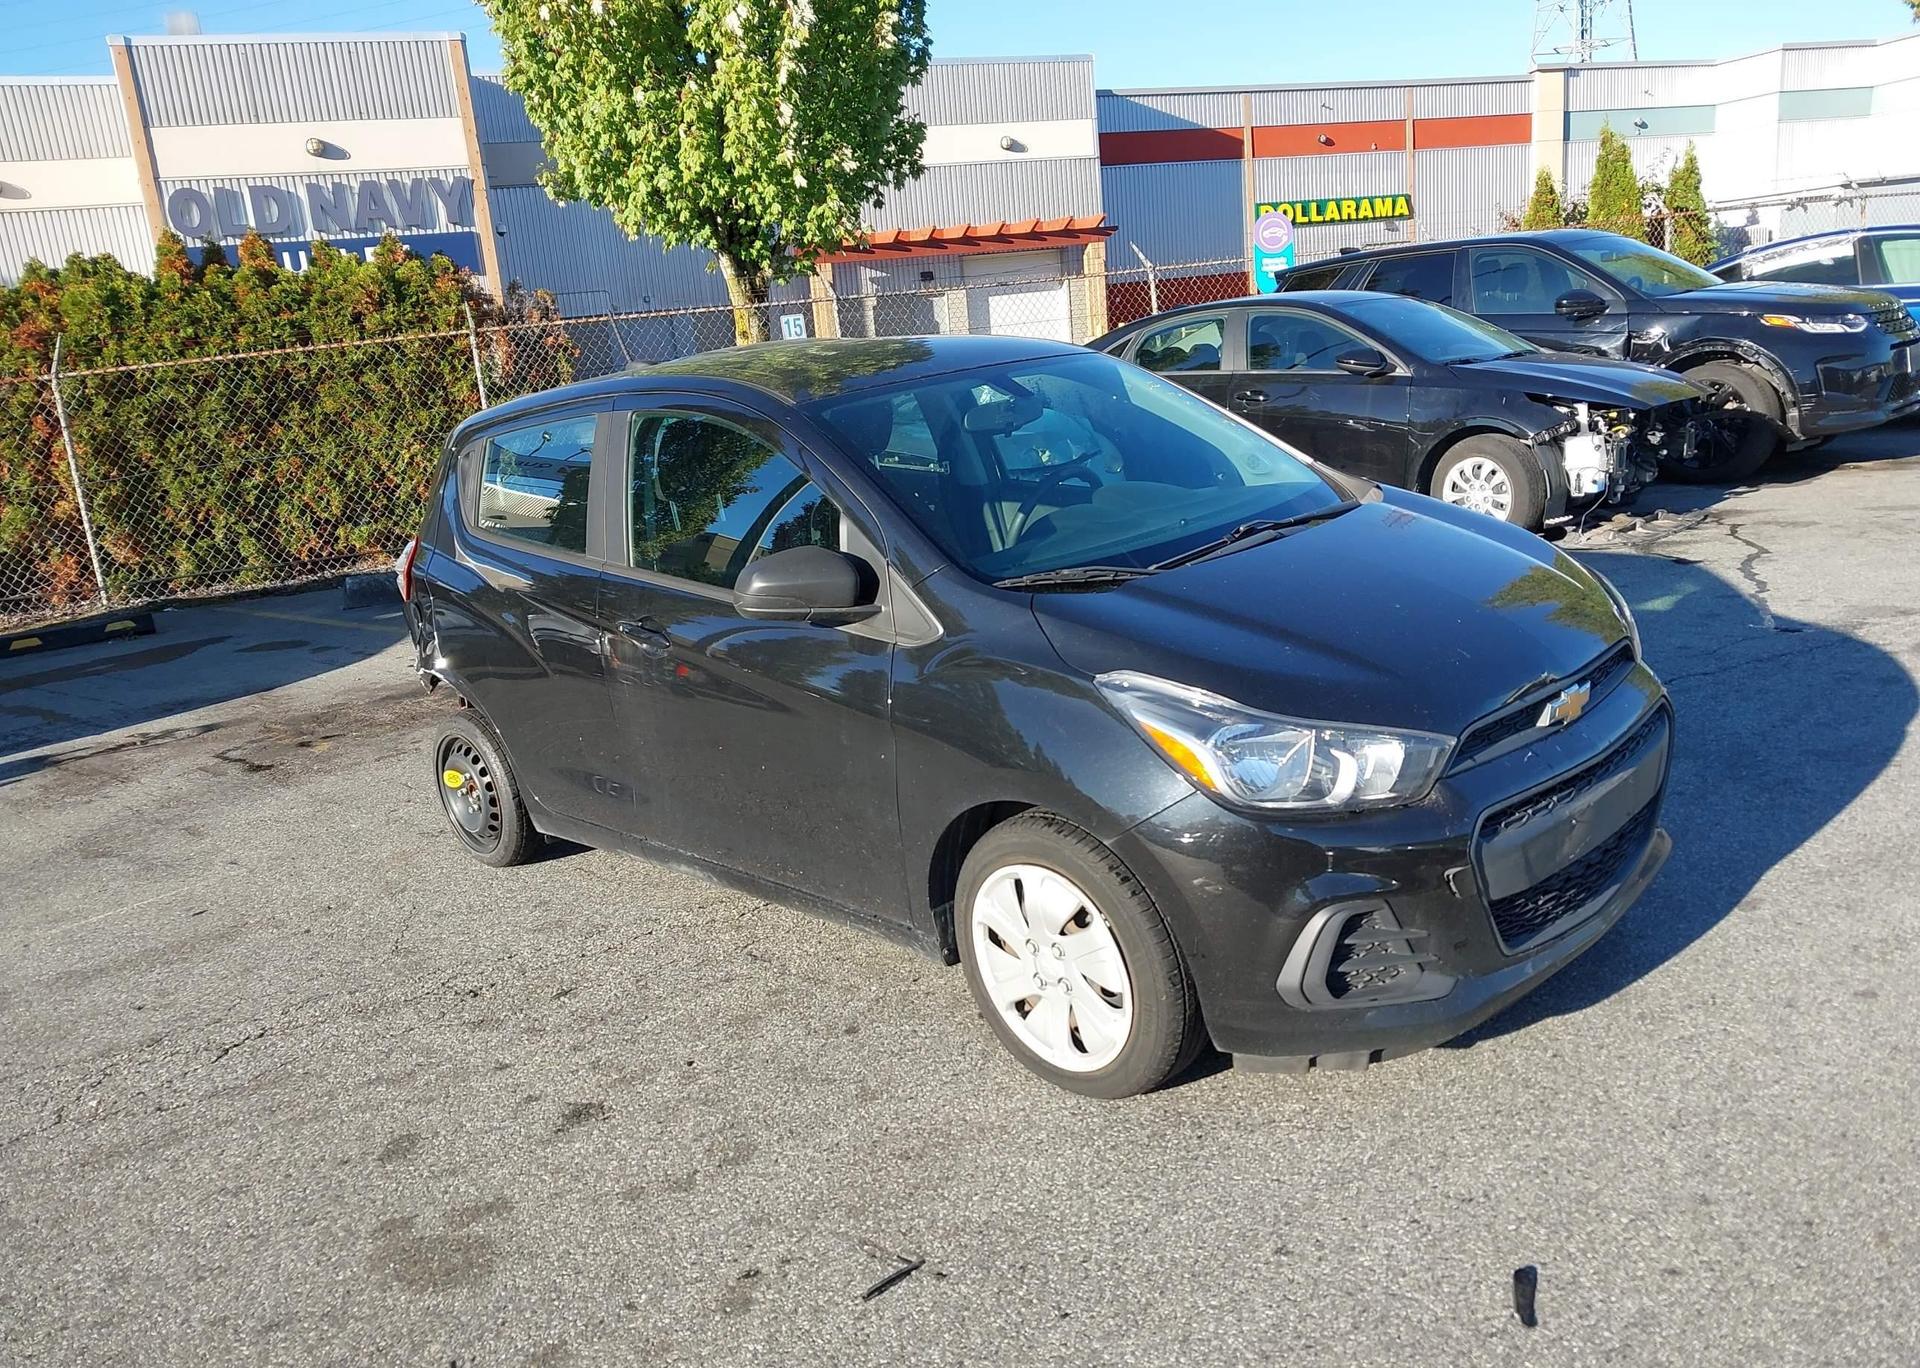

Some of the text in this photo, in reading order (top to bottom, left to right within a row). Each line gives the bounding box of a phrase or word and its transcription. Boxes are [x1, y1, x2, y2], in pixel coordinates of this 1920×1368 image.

[167, 176, 467, 239] OLD NAVY
[784, 317, 803, 337] 15
